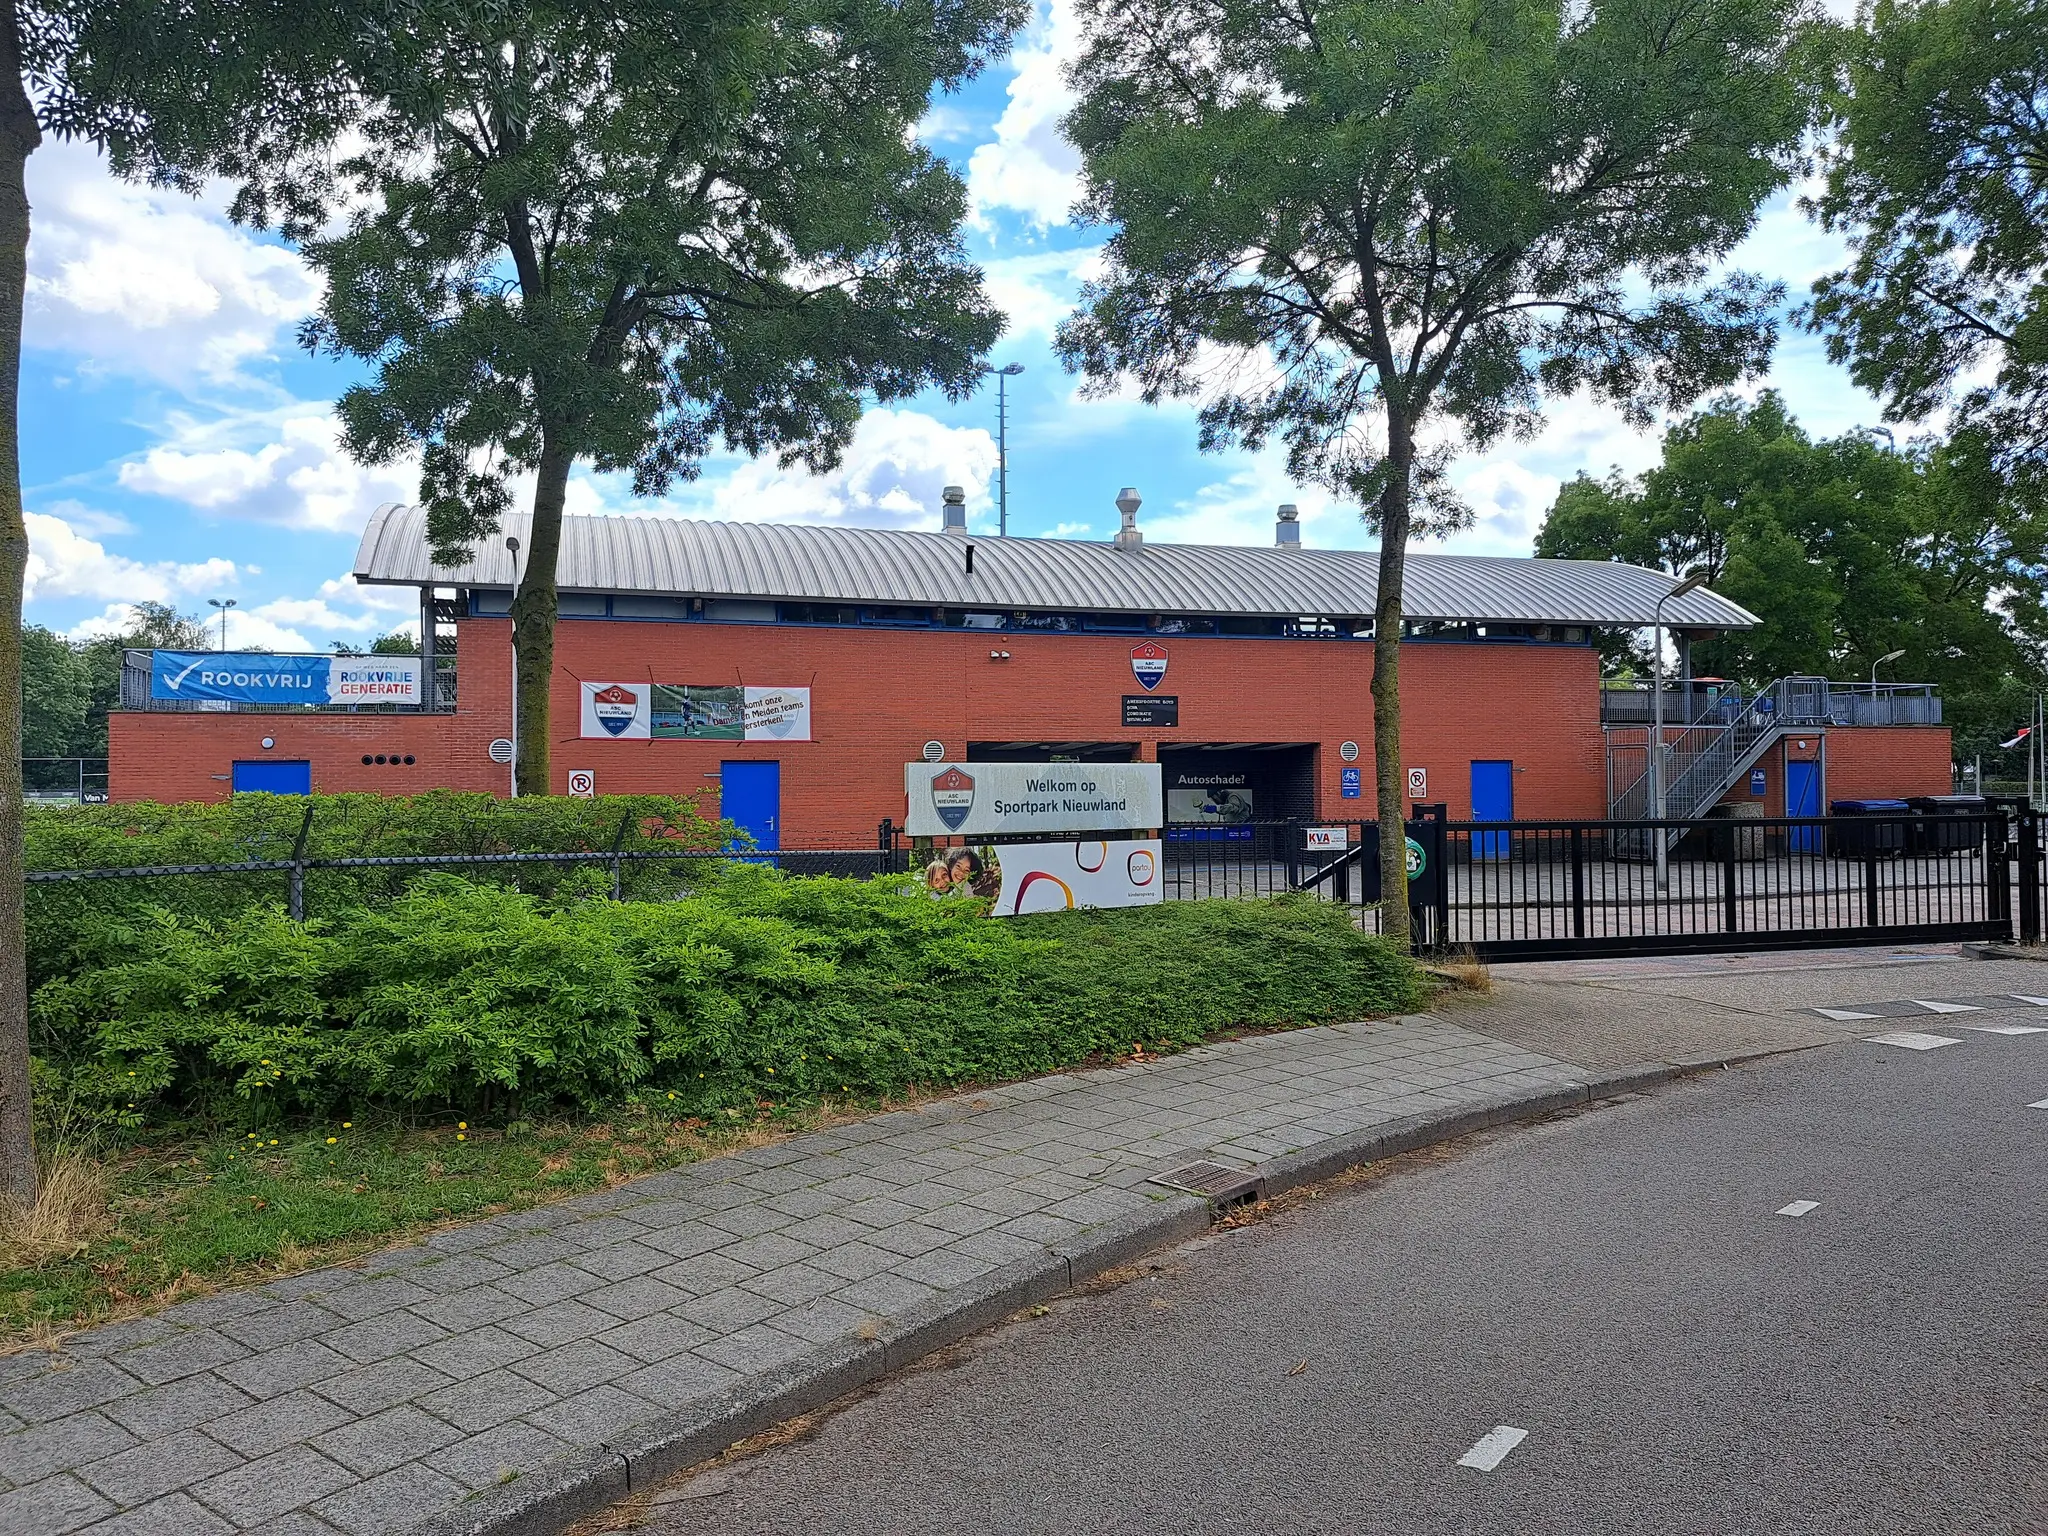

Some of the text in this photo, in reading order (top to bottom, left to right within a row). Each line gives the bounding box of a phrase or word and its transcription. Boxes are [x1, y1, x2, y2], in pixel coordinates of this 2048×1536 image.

[201, 671, 312, 689] ROOKVRIJ
[341, 672, 413, 682] ROOKVRIJE
[341, 684, 413, 694] GENERATIE
[727, 696, 783, 713] Wie komt onze
[712, 716, 739, 726] Dames
[741, 711, 751, 720] en
[751, 706, 780, 718] Meiden
[781, 701, 805, 712] teams
[741, 714, 784, 731] versterken!
[1026, 779, 1097, 795] Welkom op
[1178, 774, 1245, 785] Autoschade?
[84, 794, 100, 802] Van
[994, 798, 1126, 816] Sportpark Nieuwland
[1309, 833, 1330, 843] KVA
